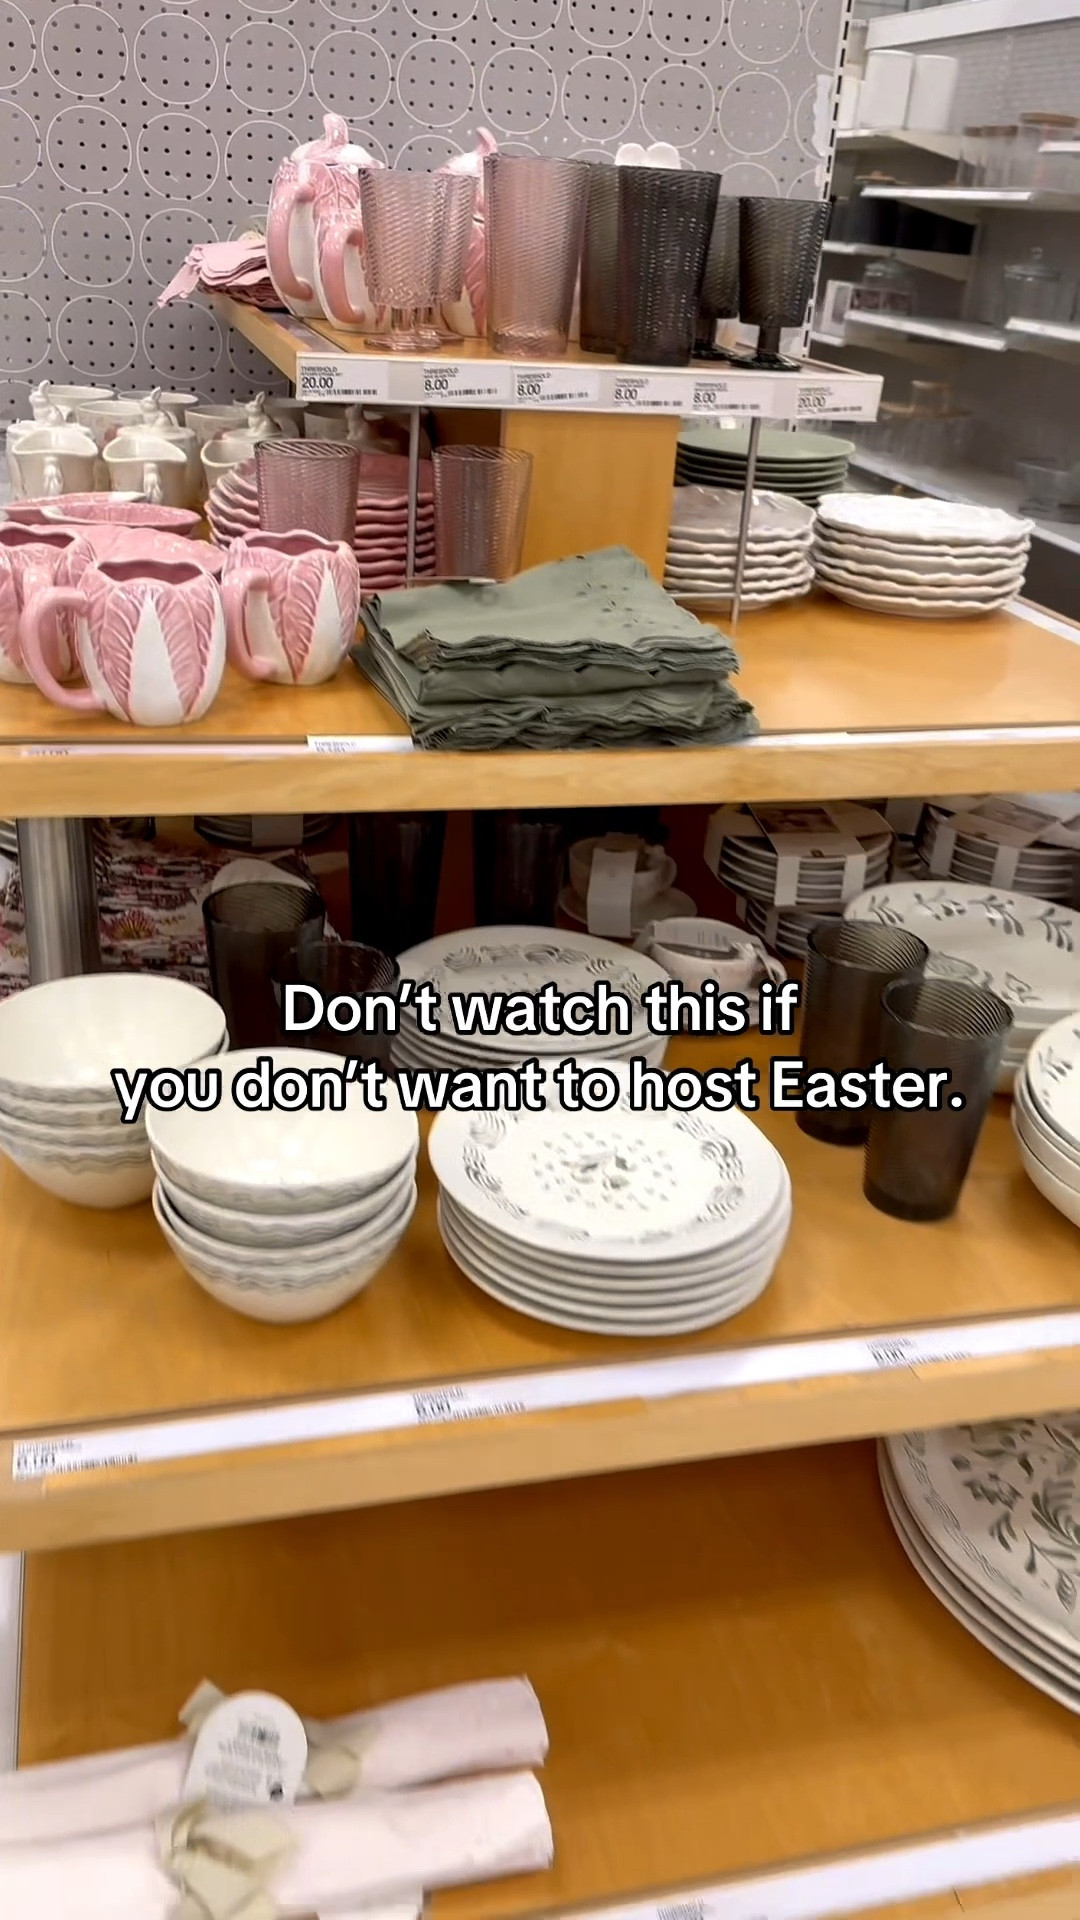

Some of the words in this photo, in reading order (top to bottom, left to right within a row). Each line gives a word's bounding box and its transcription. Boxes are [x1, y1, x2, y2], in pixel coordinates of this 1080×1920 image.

[301, 376, 334, 389] 20.00
[424, 378, 449, 391] 8.00
[516, 383, 541, 396] 8.00
[614, 388, 638, 400] 8.00
[693, 392, 717, 404] 8.00
